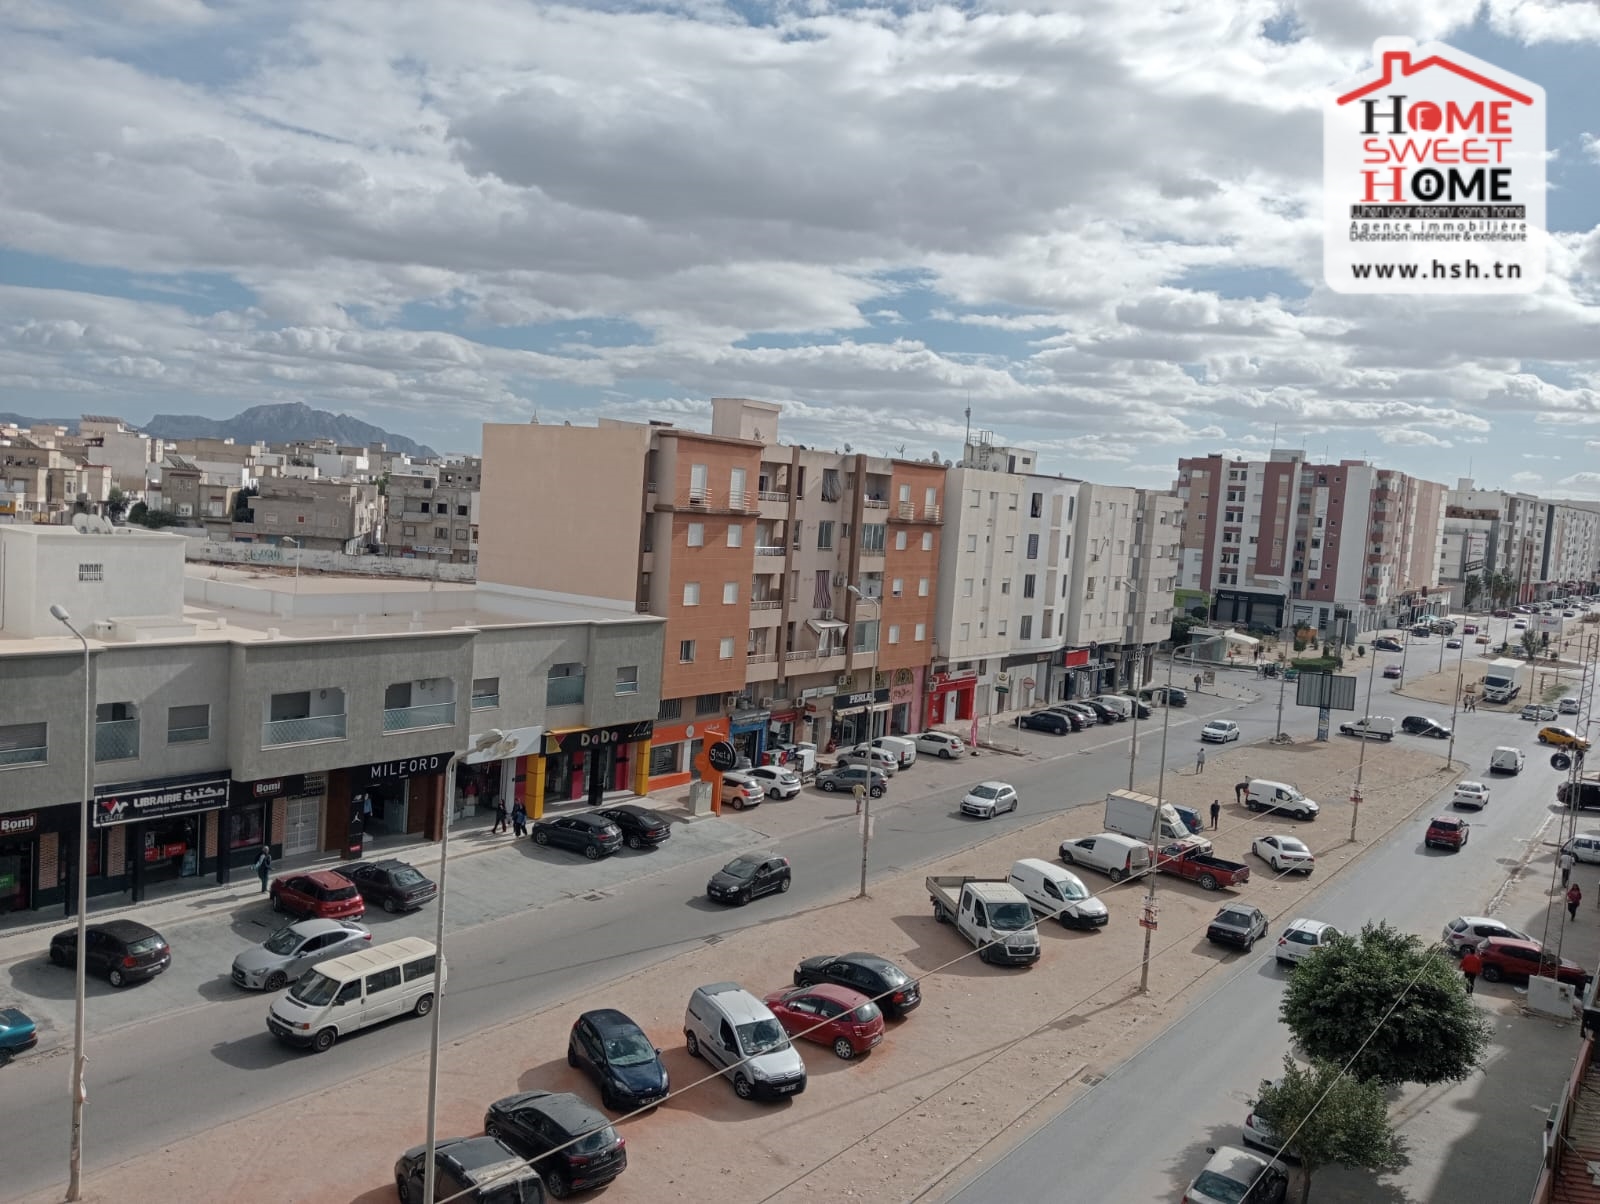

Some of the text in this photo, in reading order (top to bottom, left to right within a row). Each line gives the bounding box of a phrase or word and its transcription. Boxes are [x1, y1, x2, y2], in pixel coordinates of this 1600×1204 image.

[371, 757, 438, 778] MILFORD
[256, 780, 280, 793] Bomi
[133, 792, 182, 808] LIBRAIRIE
[183, 787, 225, 802] مكتبة
[1, 816, 34, 831] Bomi
